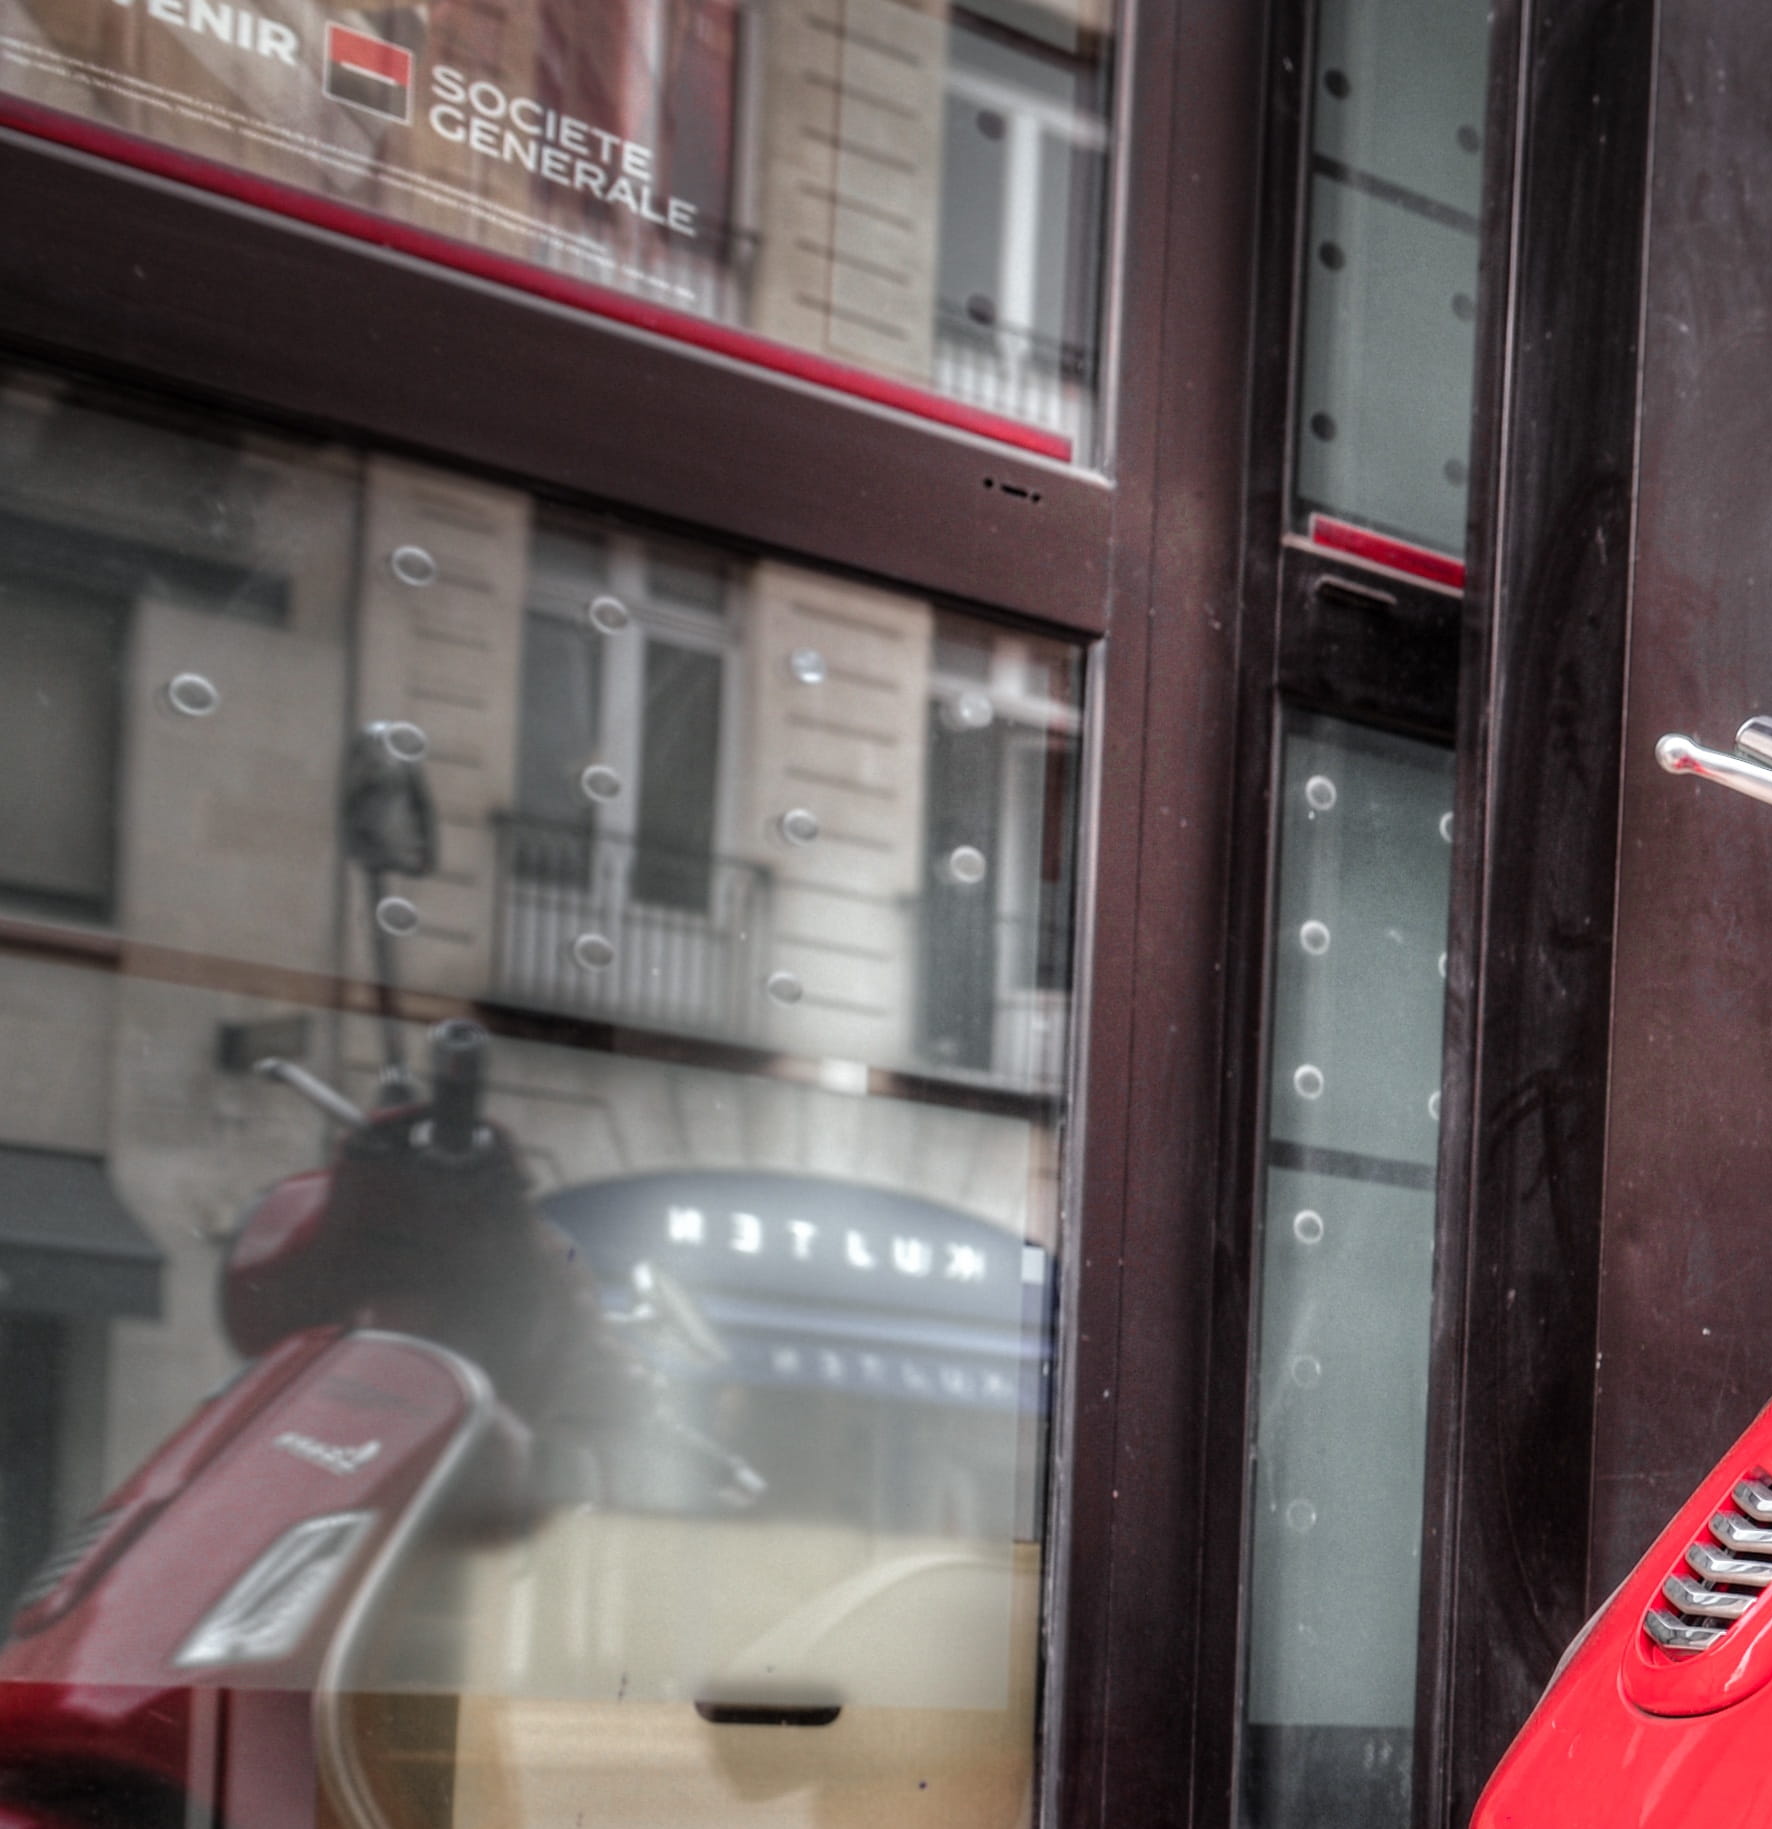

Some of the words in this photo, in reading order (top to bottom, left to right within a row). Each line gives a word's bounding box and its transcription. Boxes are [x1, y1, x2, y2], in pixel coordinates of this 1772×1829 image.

[112, 0, 296, 66] ENIR
[429, 103, 698, 238] GENERALE
[432, 64, 655, 182] SOCIETE
